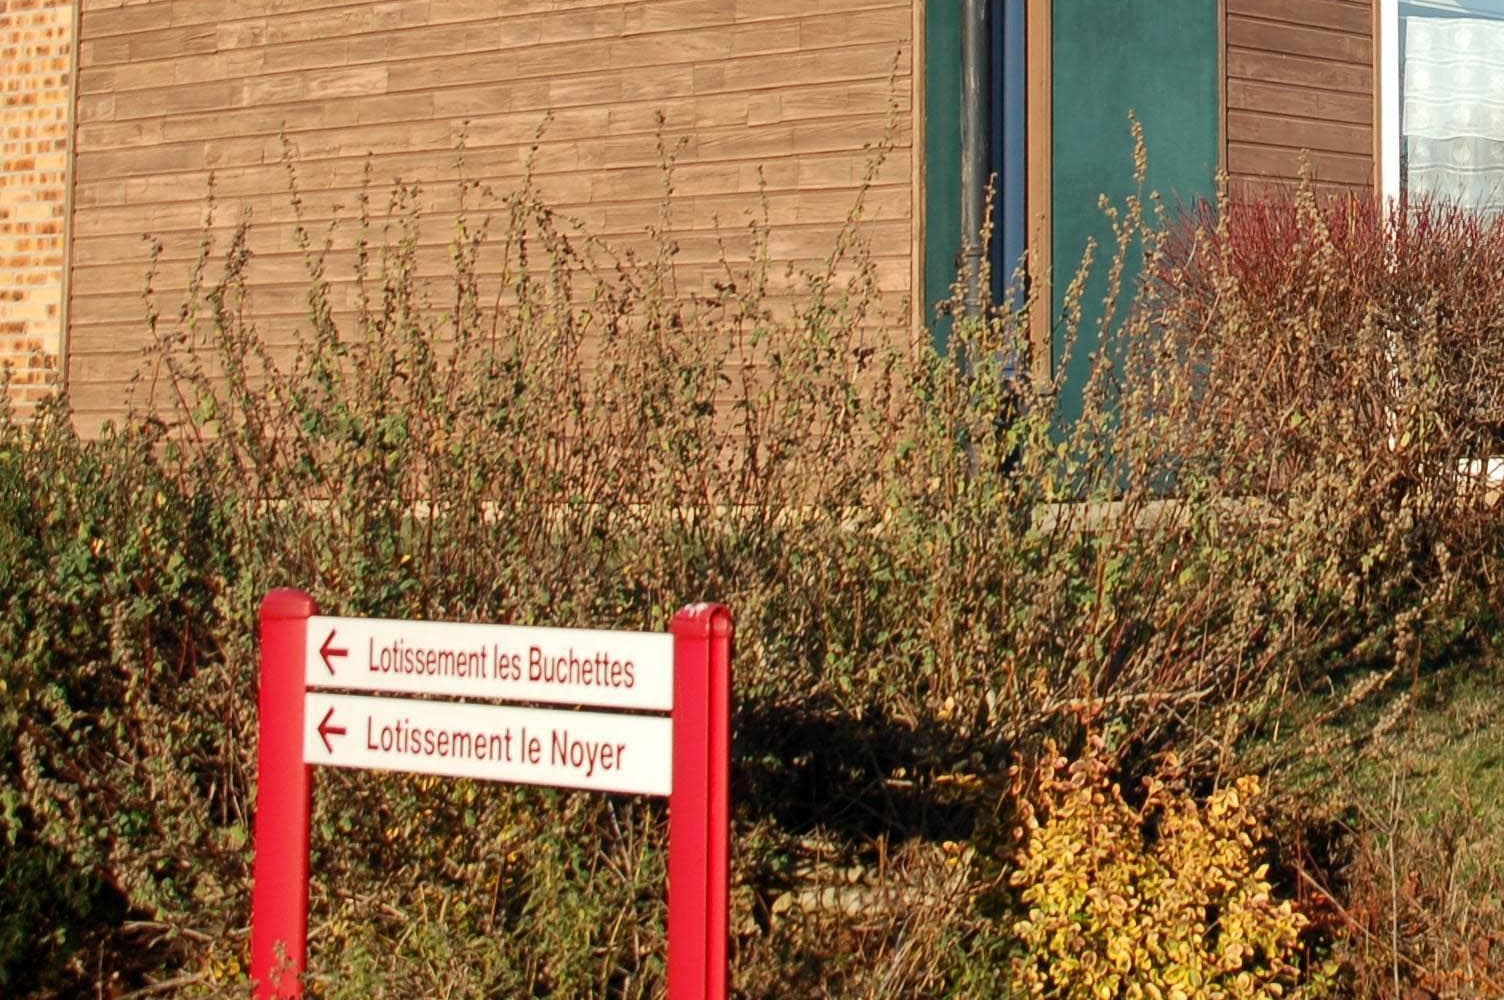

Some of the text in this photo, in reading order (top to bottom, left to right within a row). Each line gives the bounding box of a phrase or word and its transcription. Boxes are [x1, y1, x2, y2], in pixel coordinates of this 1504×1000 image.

[368, 637, 636, 689] Lotissement les Buchettes
[366, 715, 626, 777] Lotissement le Noyer
